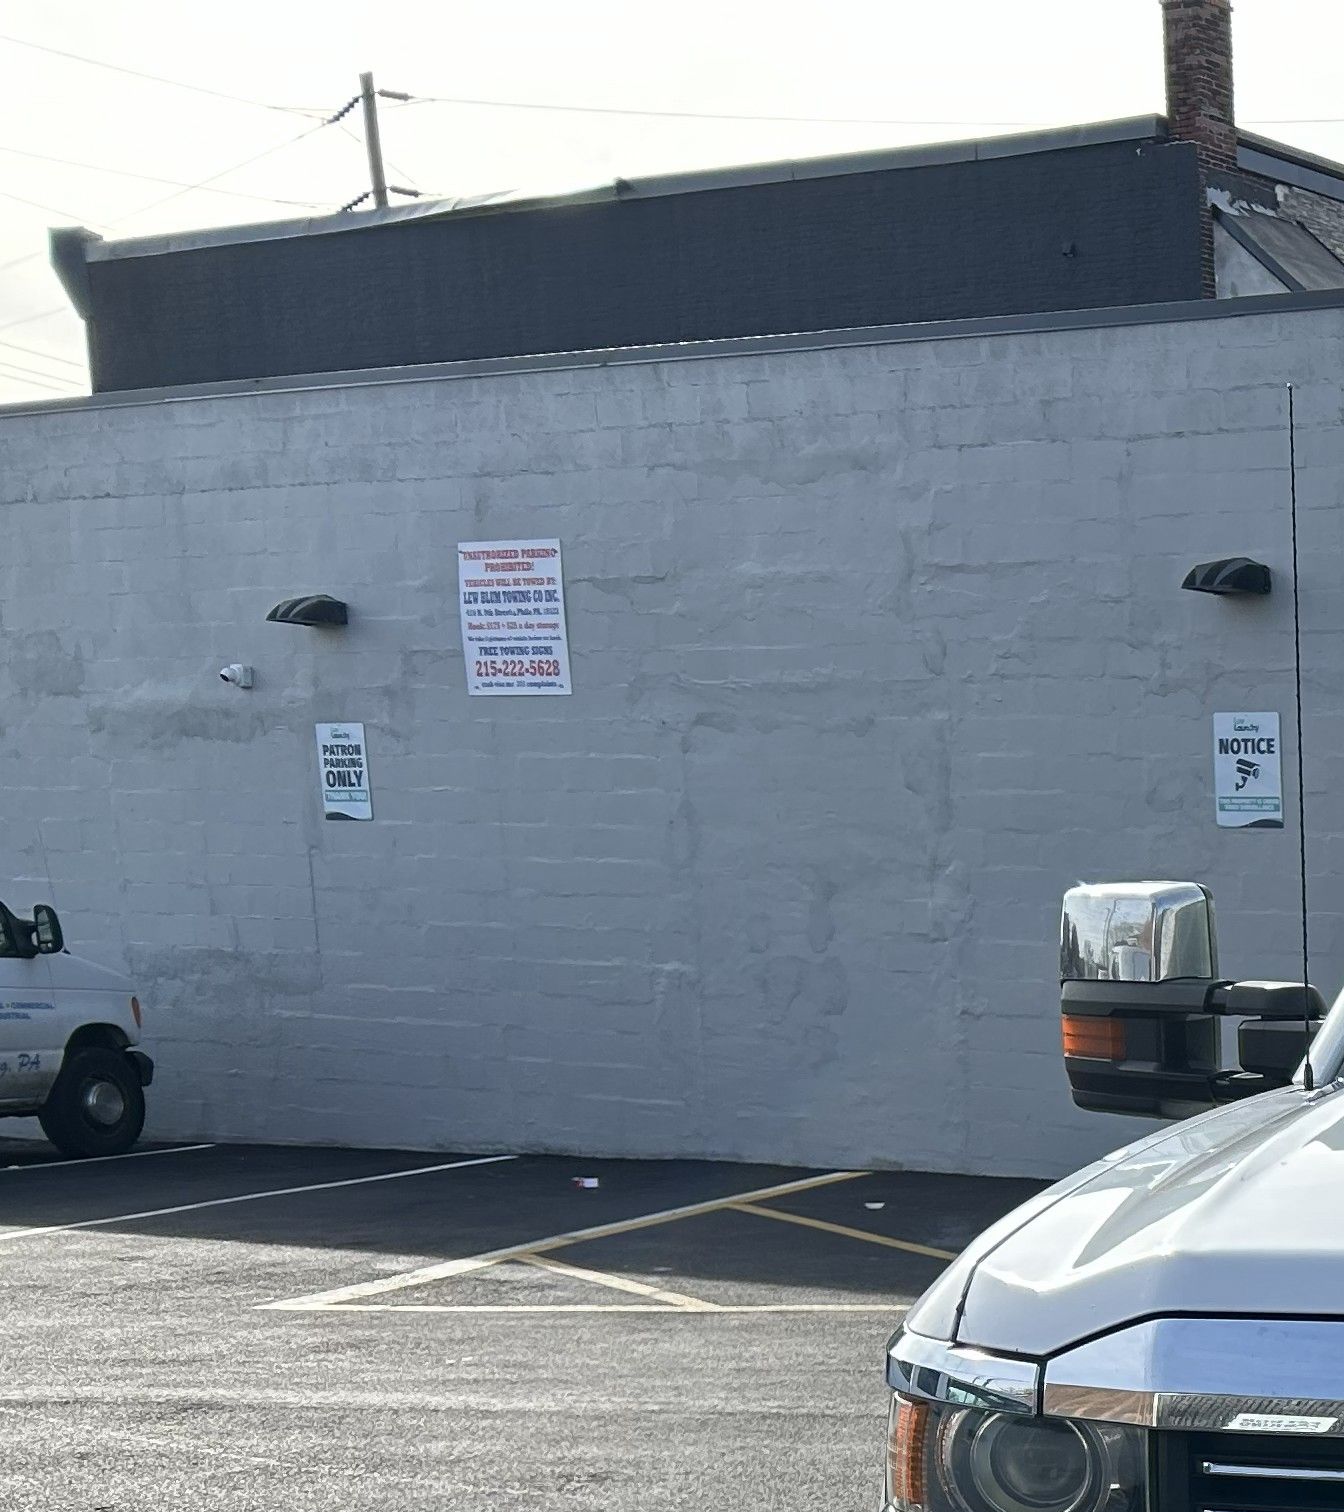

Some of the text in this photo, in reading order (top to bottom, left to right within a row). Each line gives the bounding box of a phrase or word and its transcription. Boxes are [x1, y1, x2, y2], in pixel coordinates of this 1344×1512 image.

[322, 744, 362, 756] PATRON
[1218, 737, 1276, 755] NOTICE
[323, 757, 363, 768] PARKING
[325, 770, 363, 788] ONLY
